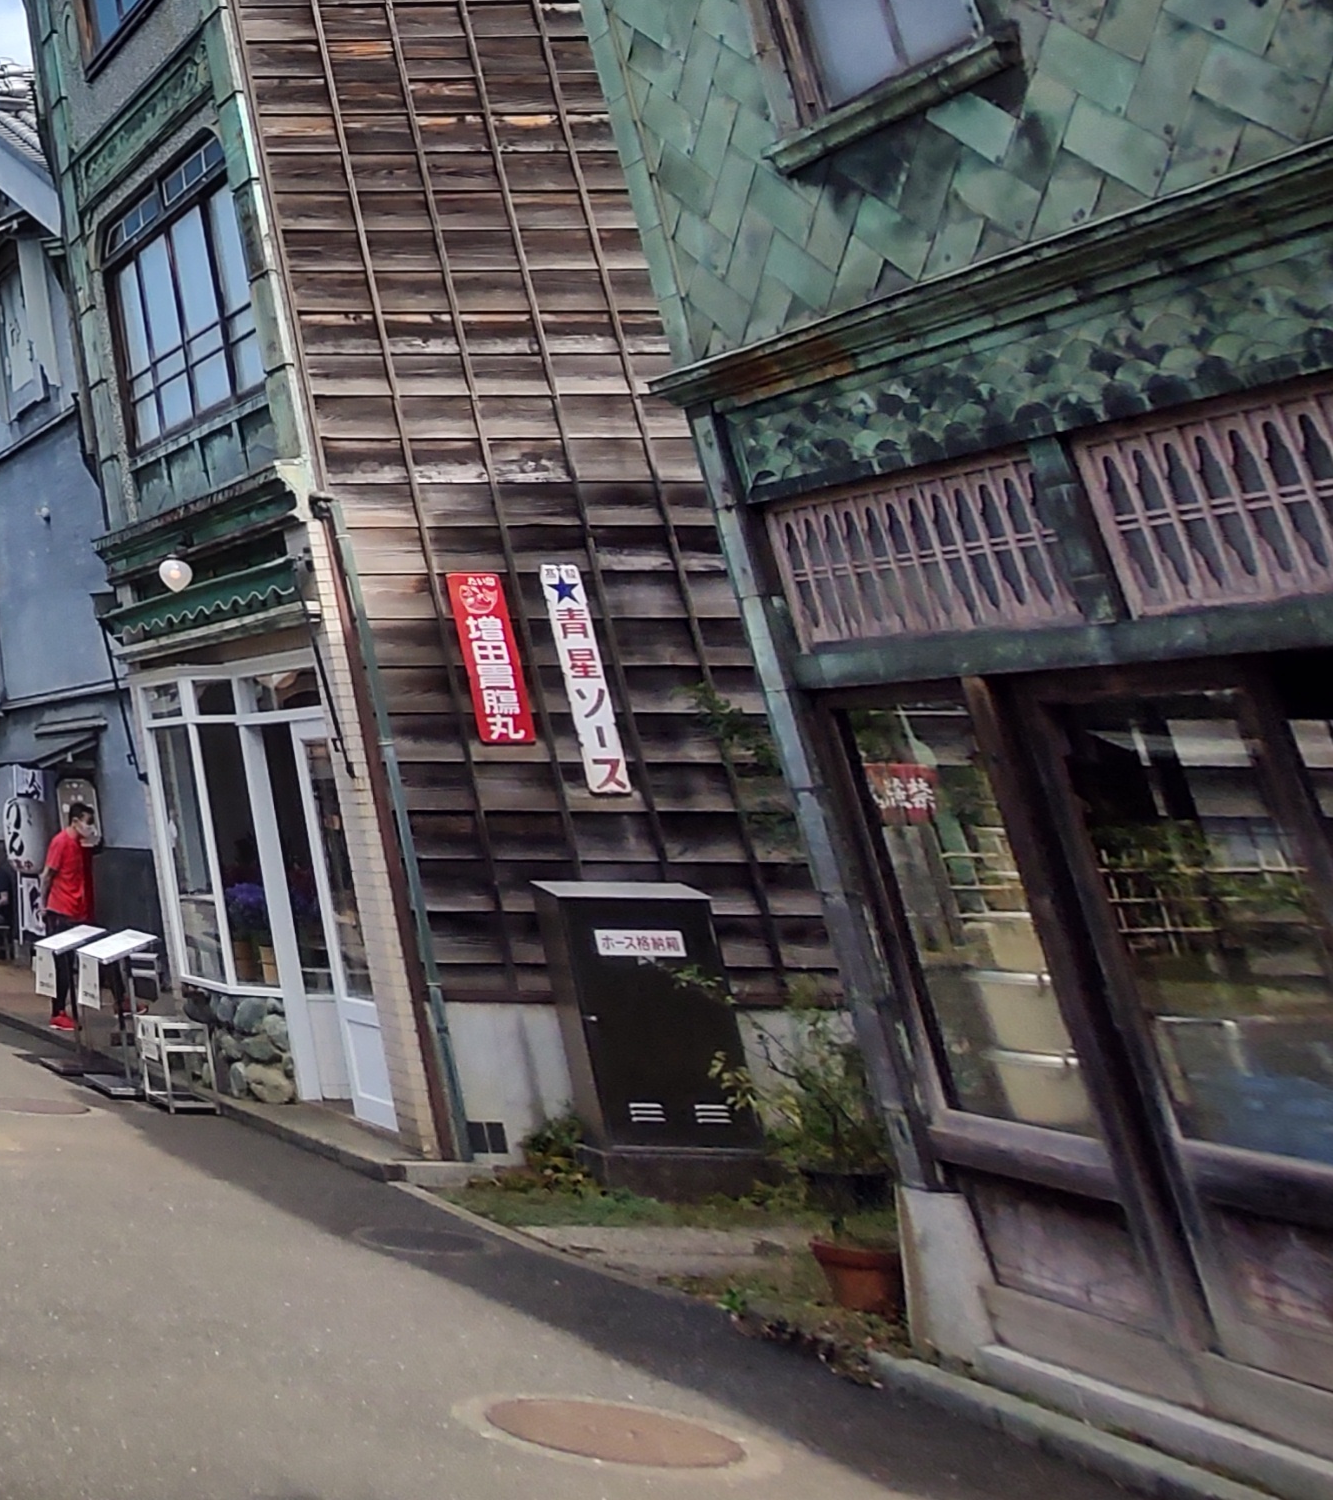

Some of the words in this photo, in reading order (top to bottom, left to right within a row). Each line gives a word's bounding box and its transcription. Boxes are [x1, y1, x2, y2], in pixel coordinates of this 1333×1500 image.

[555, 607, 628, 791] 青星ソース
[601, 935, 681, 952] ホース格納箱
